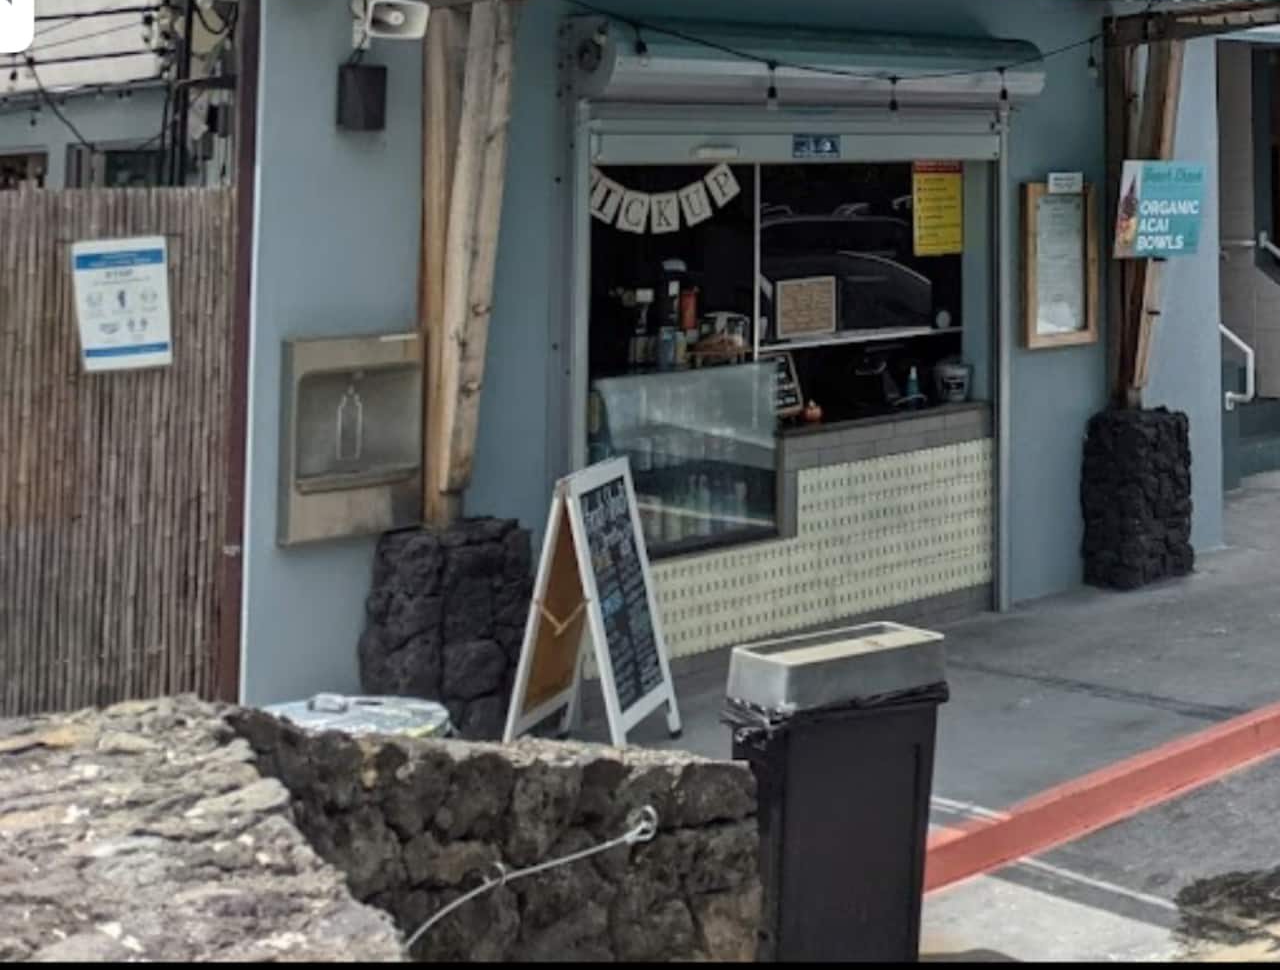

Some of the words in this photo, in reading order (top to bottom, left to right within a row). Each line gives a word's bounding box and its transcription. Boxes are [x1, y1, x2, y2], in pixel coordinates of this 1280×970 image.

[593, 171, 729, 227] ICKUP
[1140, 200, 1199, 215] ORGANIC
[1136, 235, 1184, 250] BOWLS
